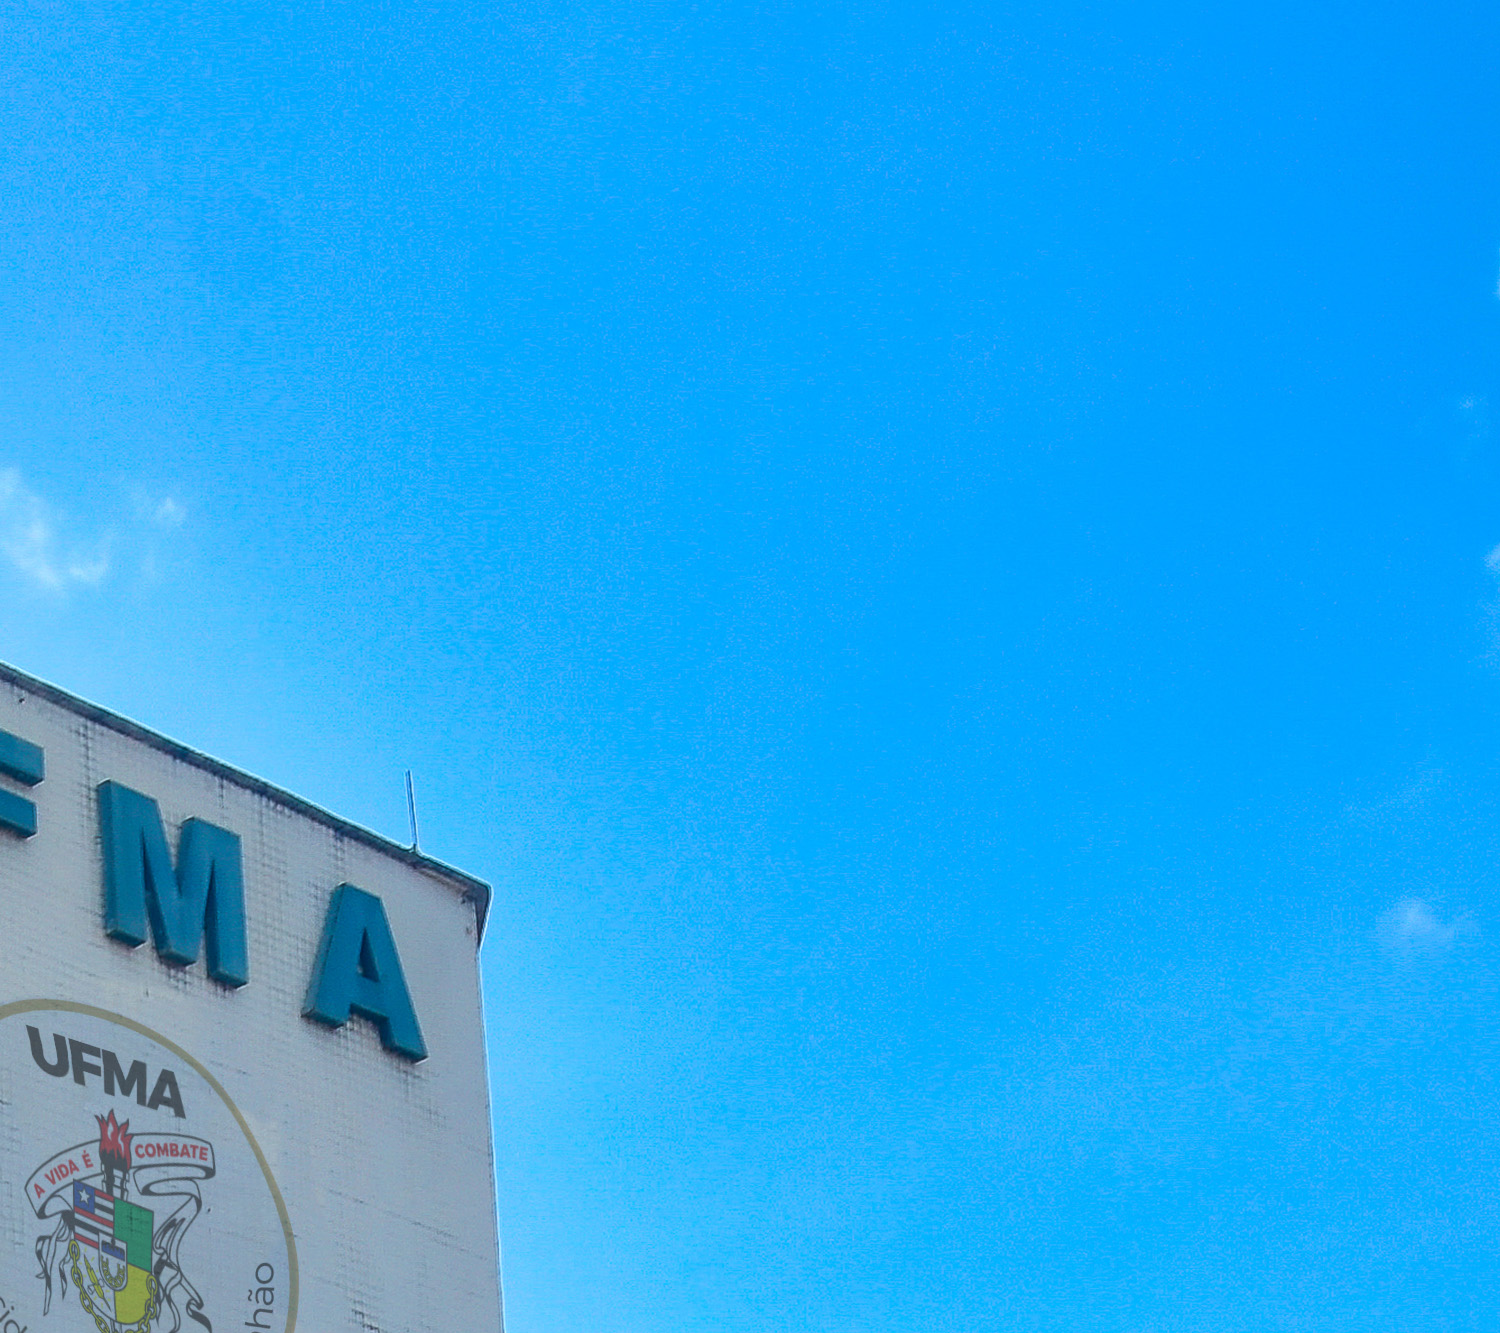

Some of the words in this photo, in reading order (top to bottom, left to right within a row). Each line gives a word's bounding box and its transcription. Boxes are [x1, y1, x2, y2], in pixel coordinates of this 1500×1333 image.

[25, 1024, 187, 1119] UFMA
[33, 1182, 46, 1199] A
[44, 1158, 80, 1186] VIDA
[81, 1149, 94, 1169] É
[134, 1142, 209, 1162] COMBATE
